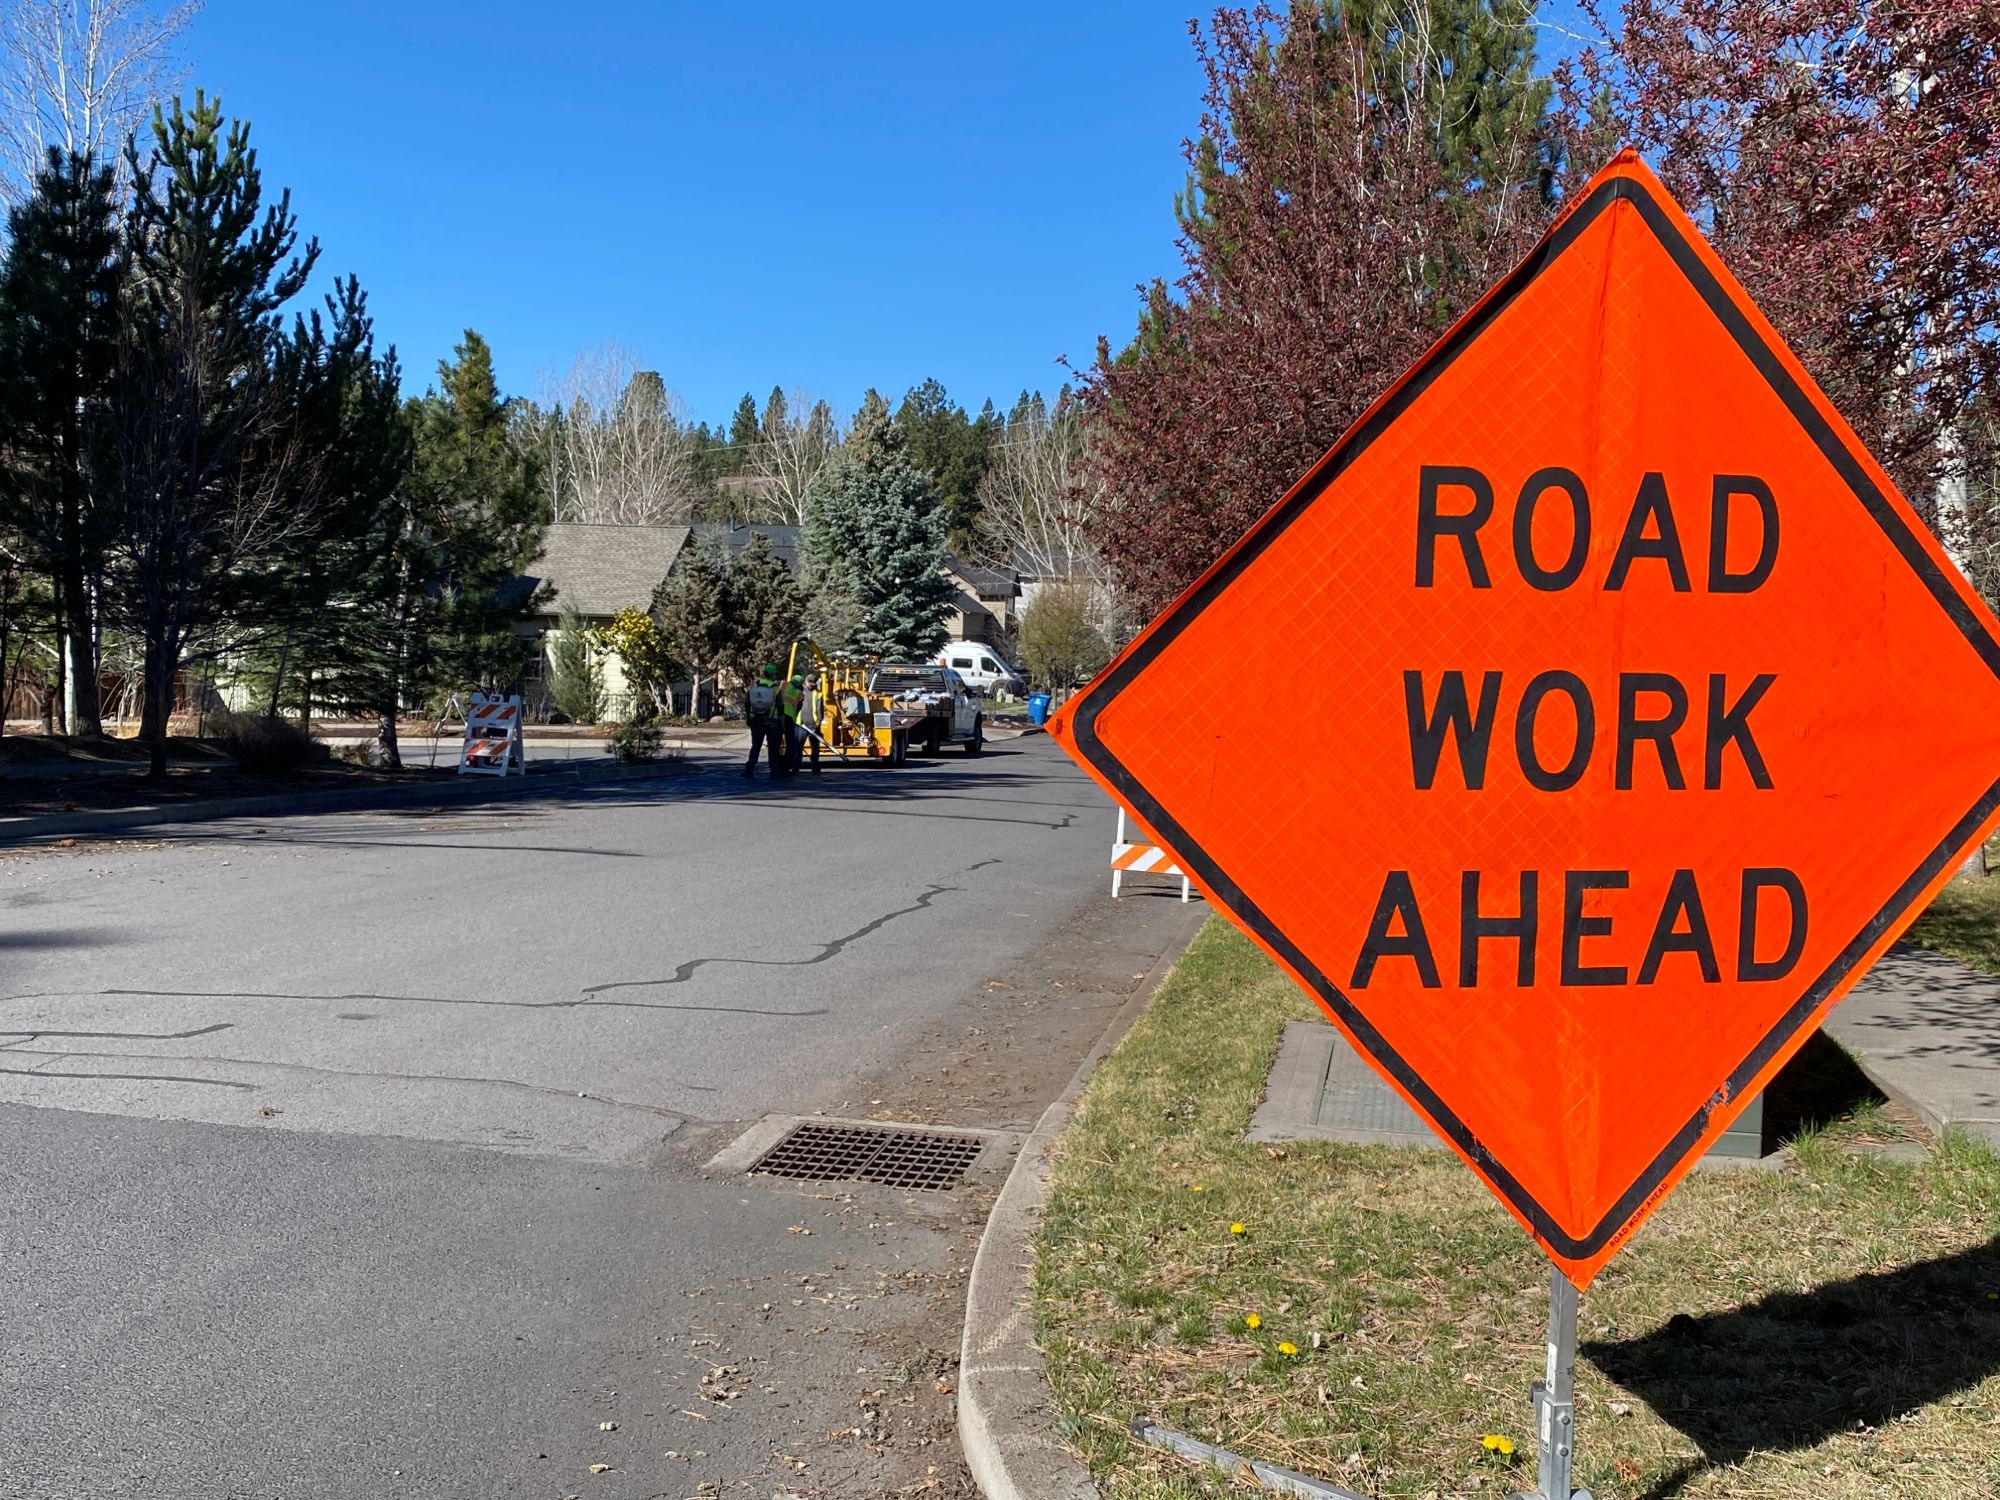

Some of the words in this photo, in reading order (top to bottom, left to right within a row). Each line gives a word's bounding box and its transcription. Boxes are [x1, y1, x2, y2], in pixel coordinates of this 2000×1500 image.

[1572, 186, 1591, 207] ROAD
[1415, 465, 1780, 594] ROAD
[1403, 670, 1780, 792] WORK
[1350, 868, 1808, 990] AHEAD
[1609, 1227, 1629, 1248] ROAD
[1628, 1207, 1647, 1228] WORK
[1646, 1183, 1668, 1208] AHEAD
